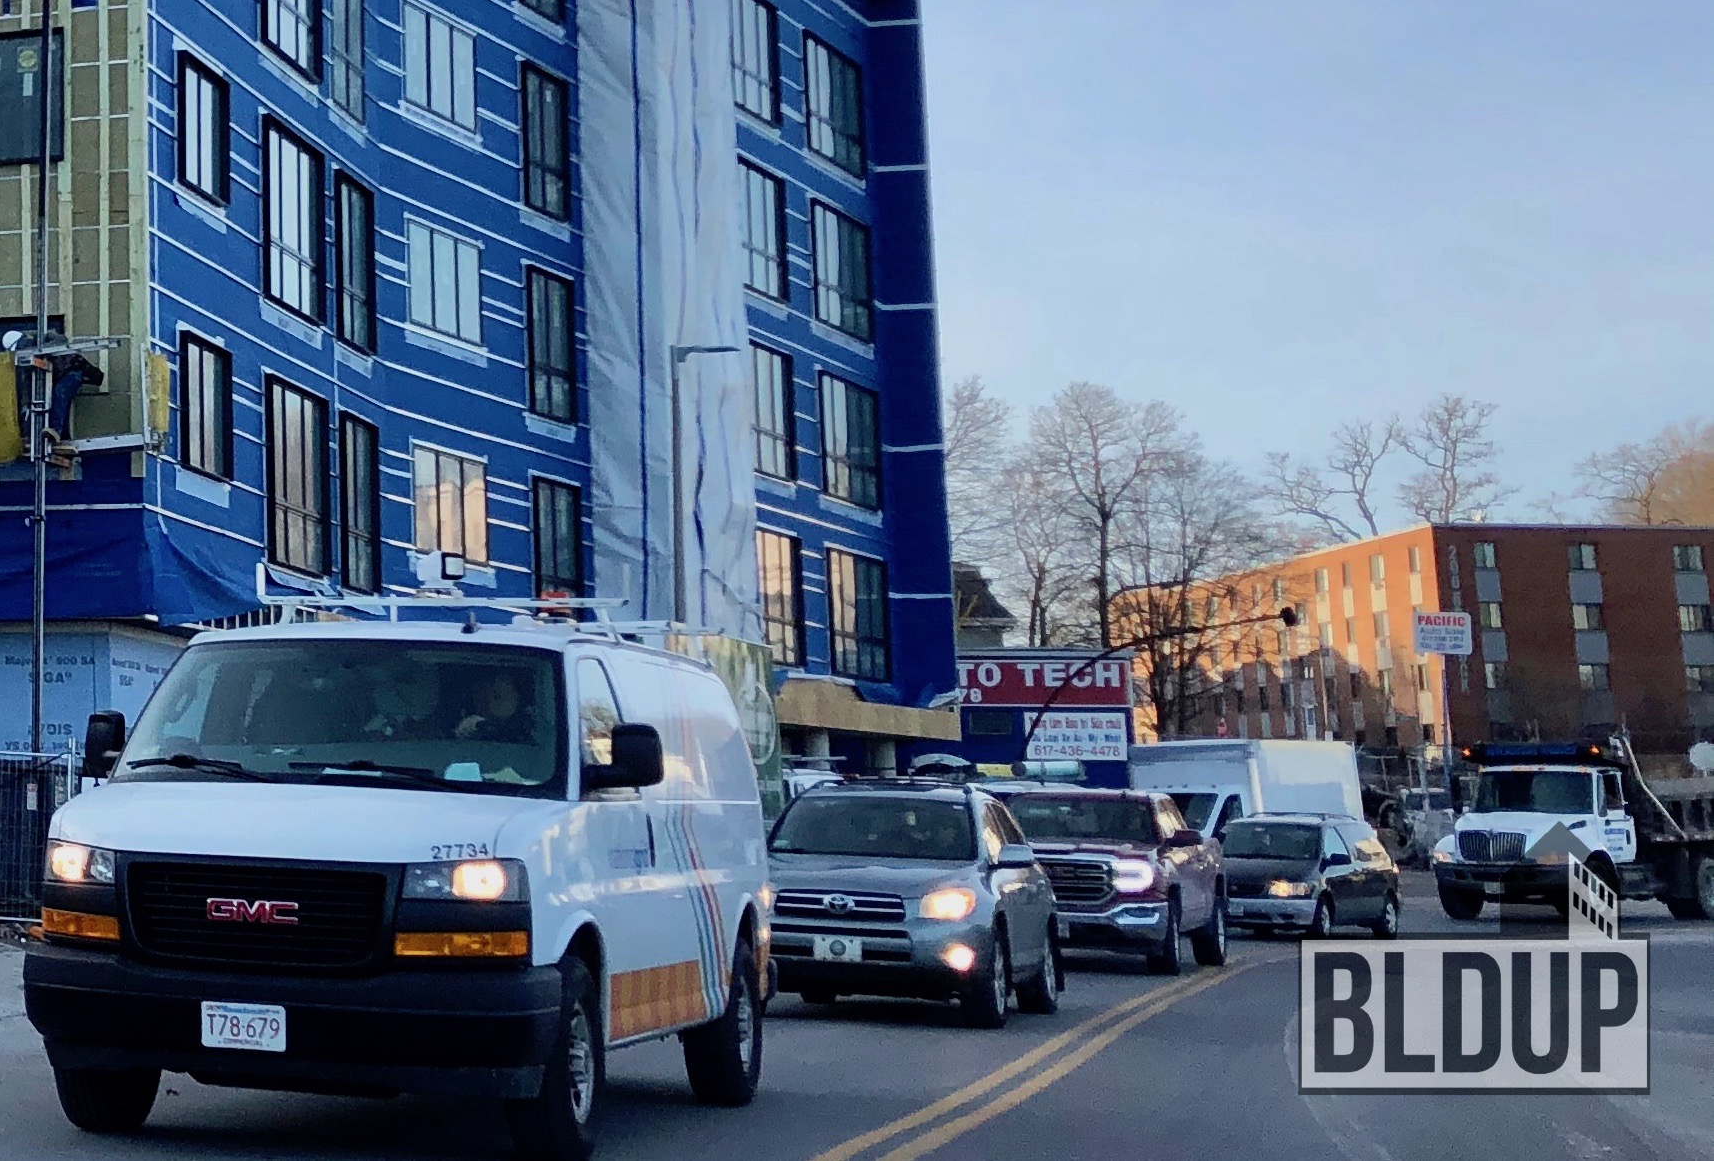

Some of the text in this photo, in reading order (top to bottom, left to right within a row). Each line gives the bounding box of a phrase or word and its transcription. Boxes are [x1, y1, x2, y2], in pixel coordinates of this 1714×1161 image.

[1417, 615, 1466, 627] PACIFIC
[1017, 663, 1121, 688] TECH
[1034, 744, 1121, 757] 617-436-4478
[431, 843, 489, 859] 27734
[206, 898, 299, 925] GMC
[206, 1013, 280, 1039] T78-679
